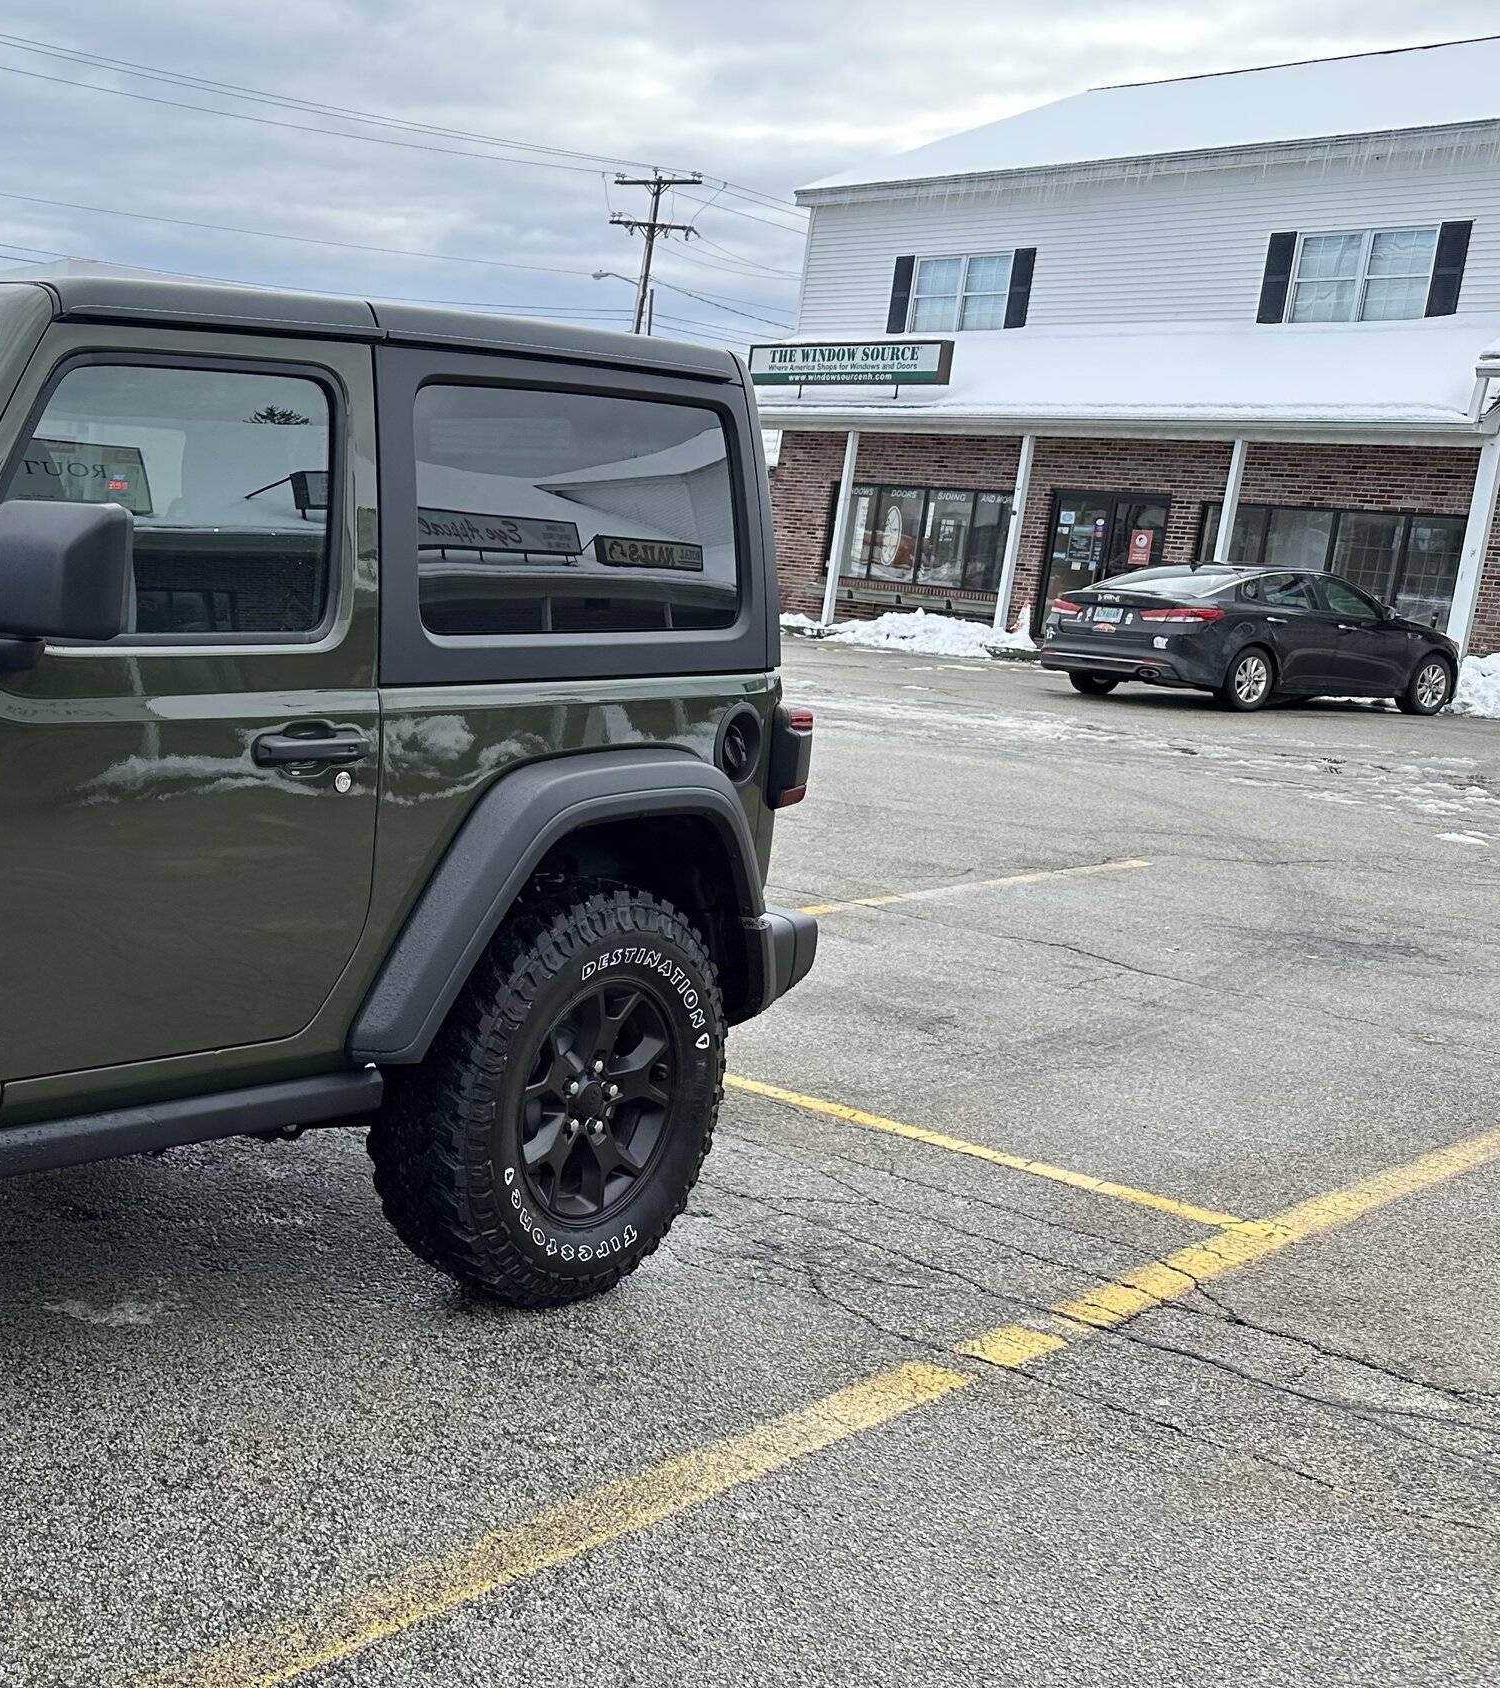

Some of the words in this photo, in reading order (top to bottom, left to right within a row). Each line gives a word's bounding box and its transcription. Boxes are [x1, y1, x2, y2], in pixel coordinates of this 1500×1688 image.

[770, 349, 797, 363] THE
[801, 347, 859, 362] WINDOW
[861, 346, 920, 361] SOURCE
[817, 363, 837, 371] Shops
[882, 362, 895, 370] and
[788, 373, 893, 381] www.windowsourcenh.com
[890, 489, 917, 499] DOORS
[937, 492, 967, 502] SIDING
[581, 947, 707, 1030] DESTINATION
